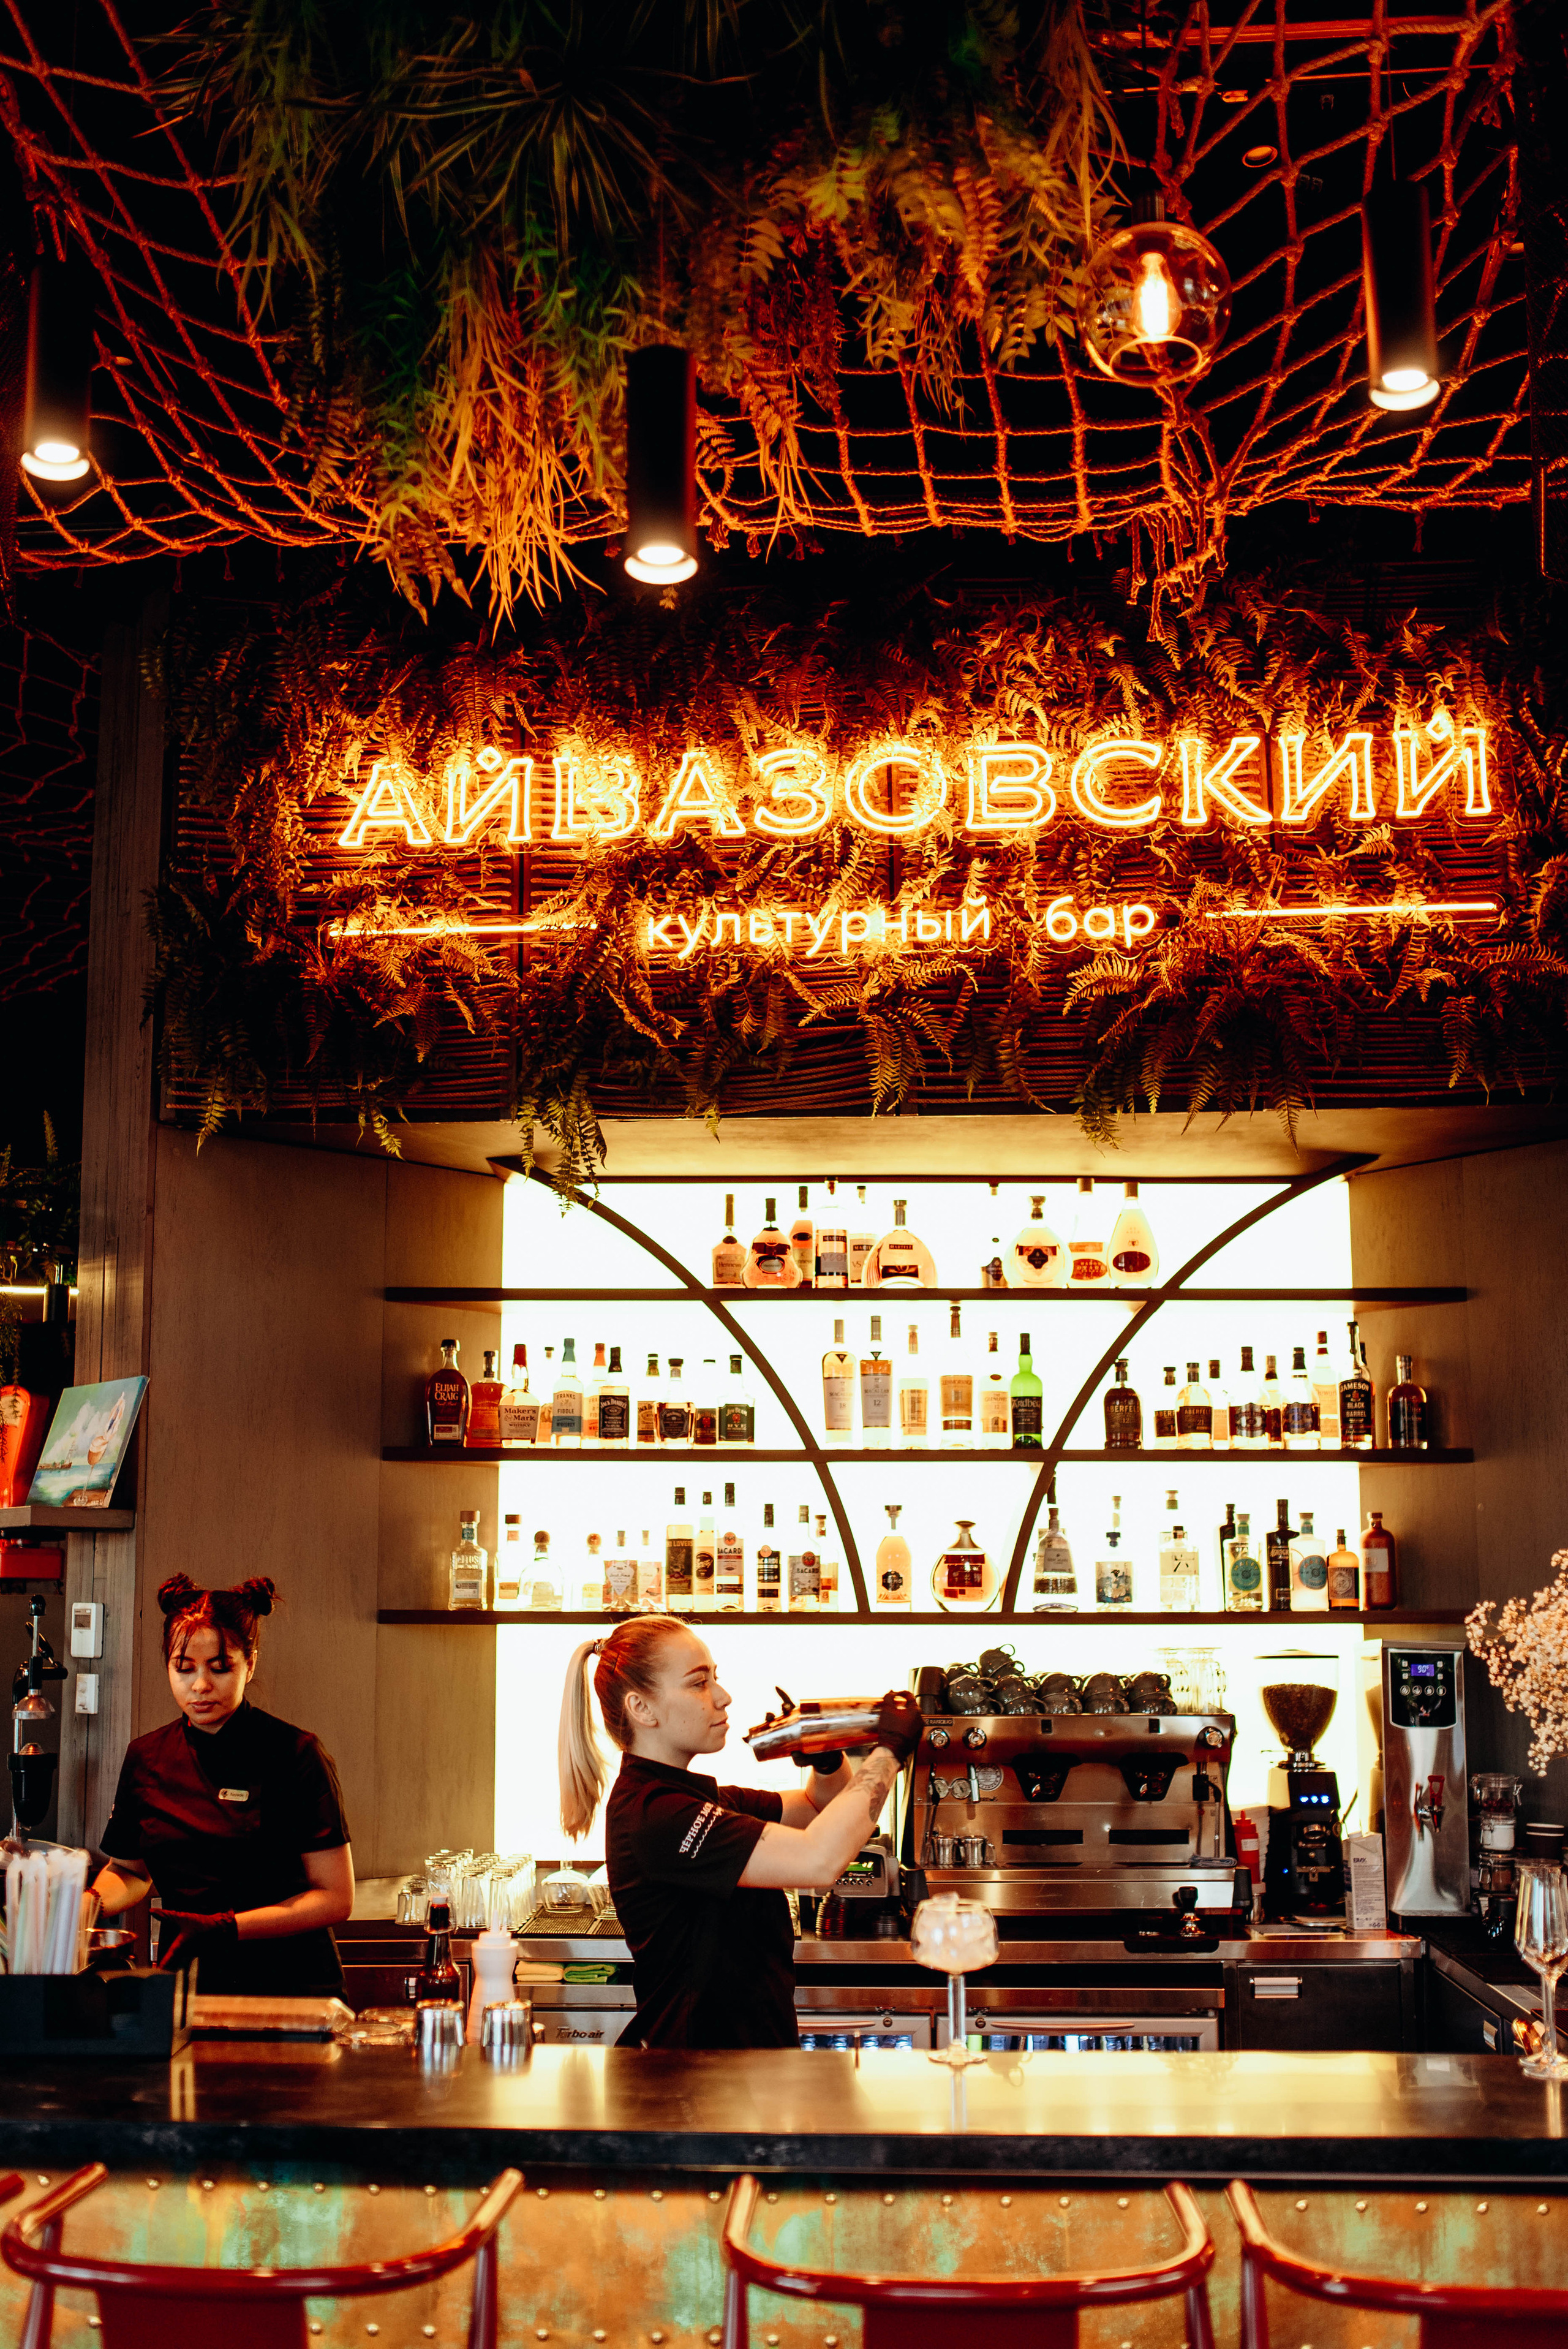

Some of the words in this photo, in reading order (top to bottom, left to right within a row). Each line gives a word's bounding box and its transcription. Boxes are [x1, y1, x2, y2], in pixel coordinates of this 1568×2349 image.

[337, 716, 1493, 848] АЙВАЗОВСКИЙ
[647, 896, 992, 959] культурный
[1045, 896, 1157, 947] бар
[435, 1383, 459, 1392] ELIJAH
[1340, 1382, 1370, 1393] JAMESON
[434, 1391, 459, 1401] CRAIG
[556, 2026, 587, 2038] Turbo
[587, 2029, 605, 2038] air
